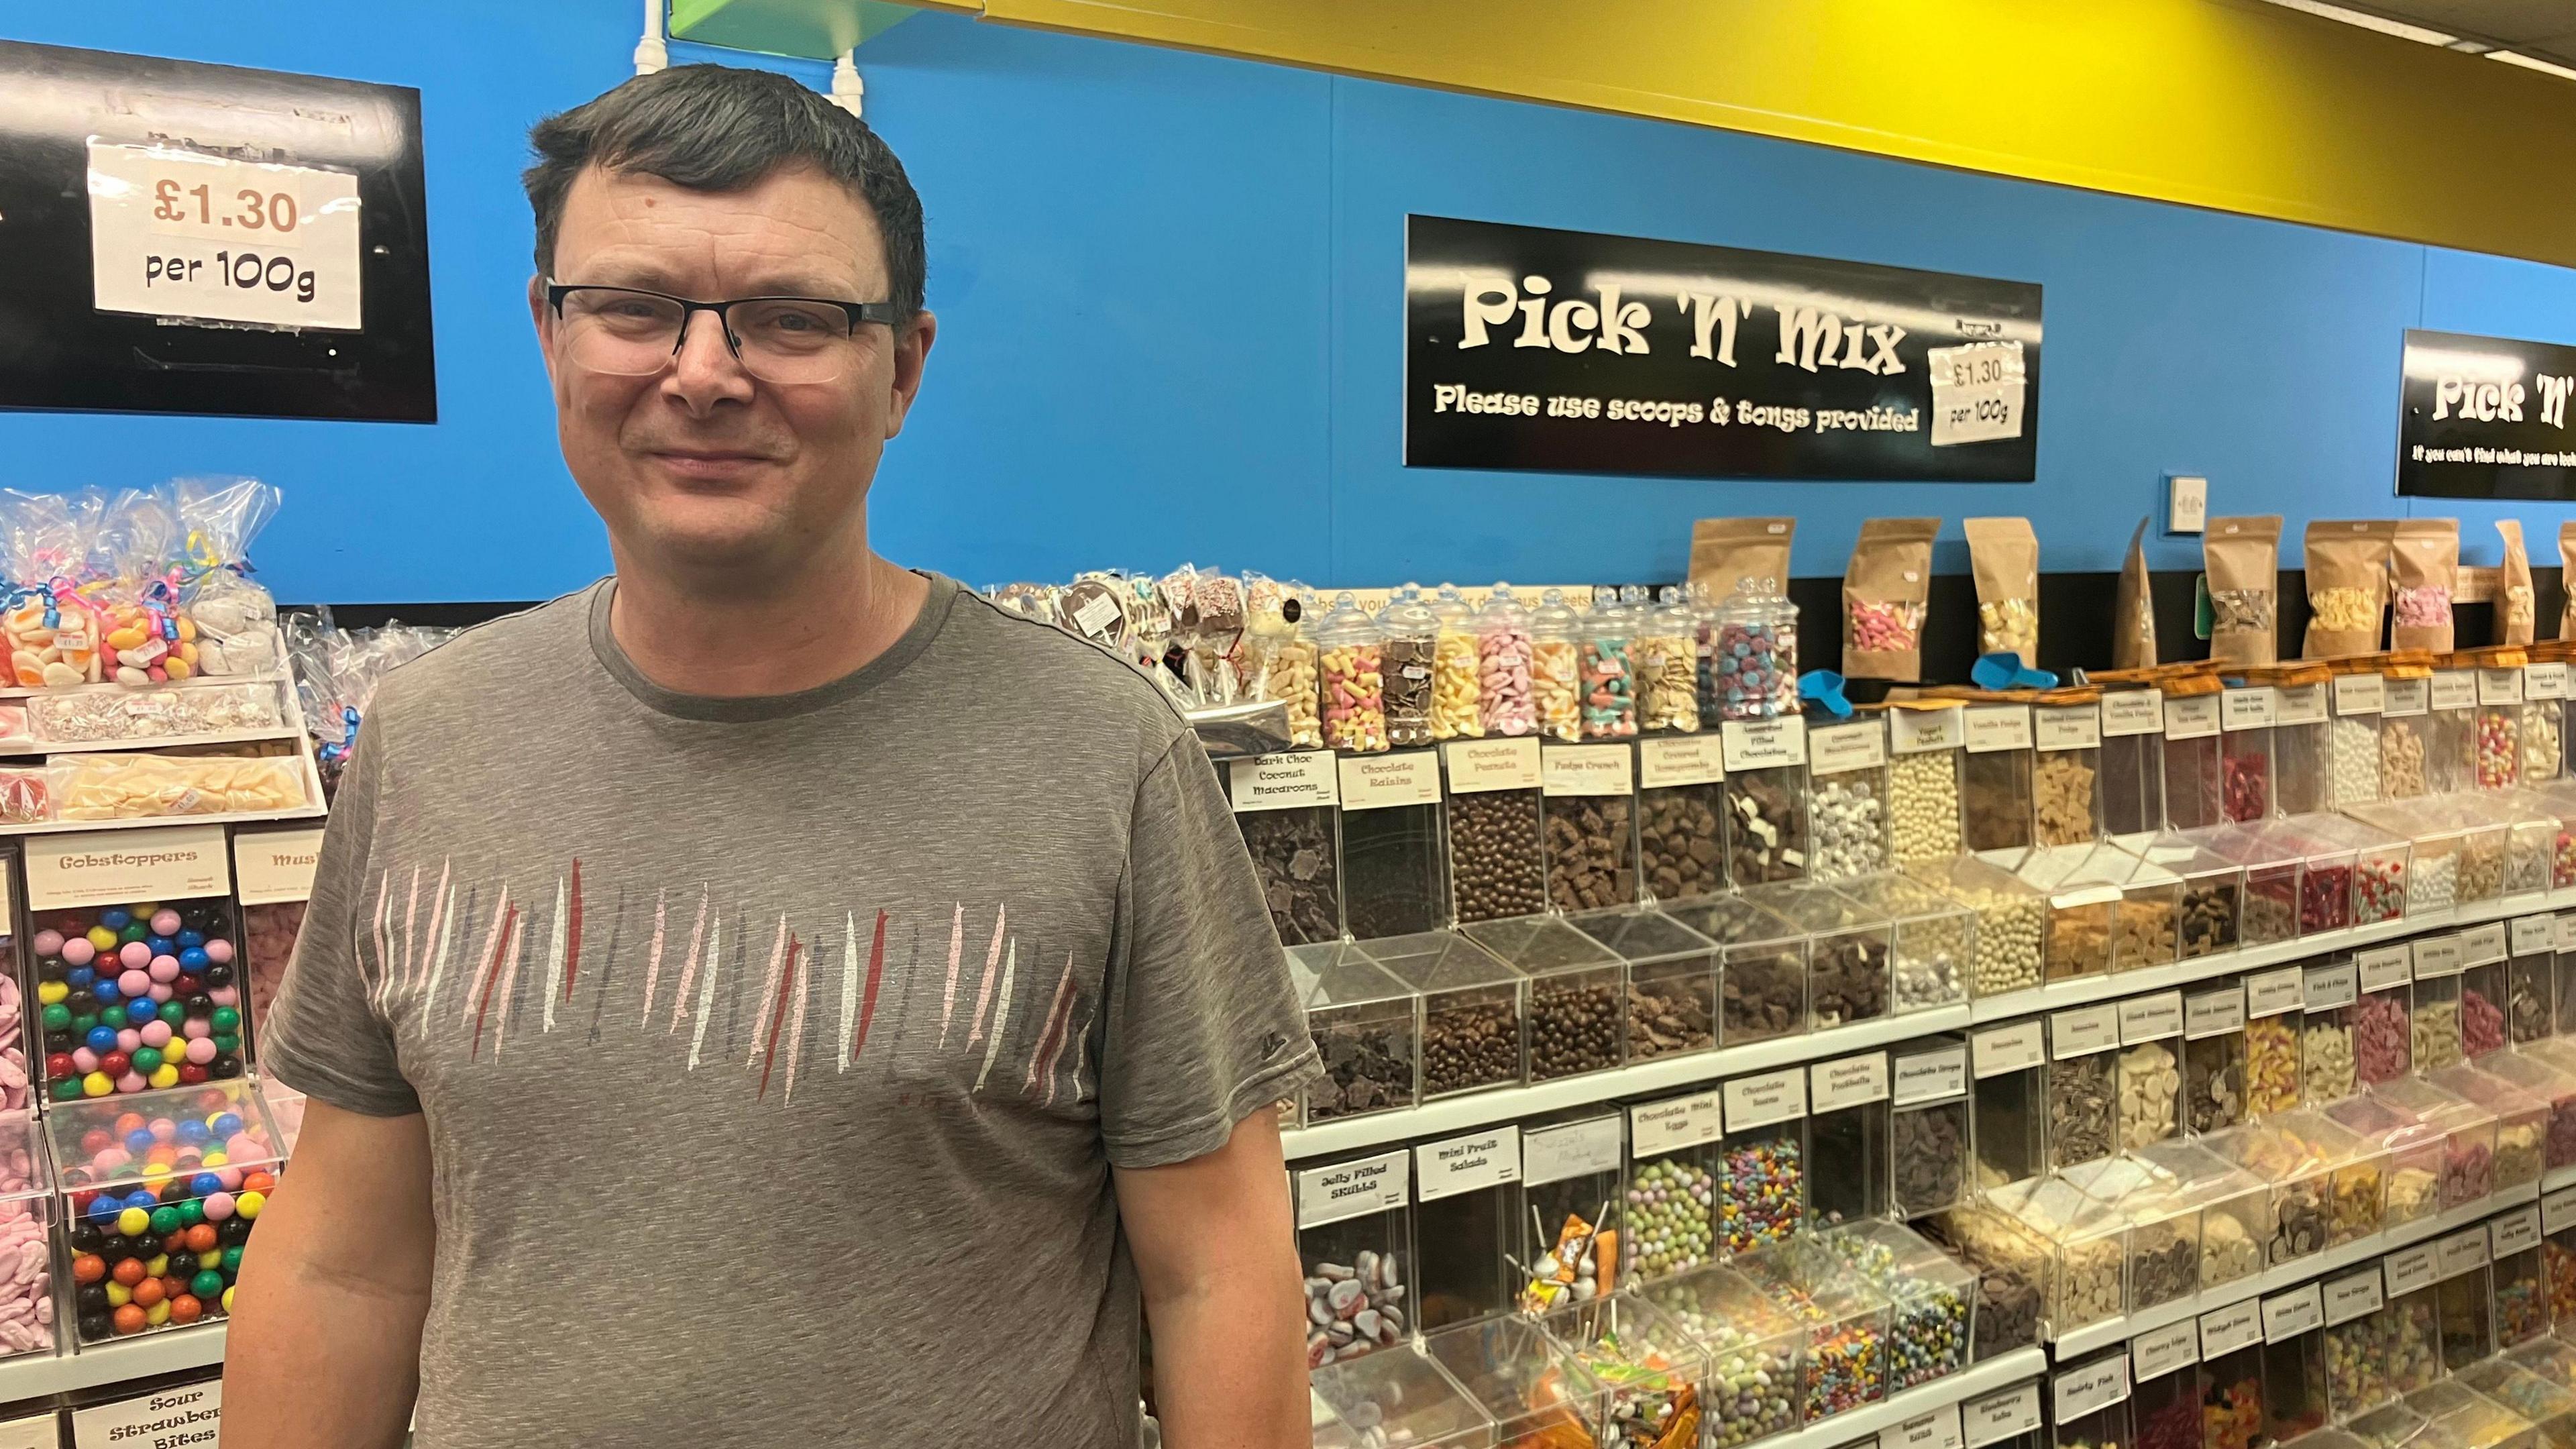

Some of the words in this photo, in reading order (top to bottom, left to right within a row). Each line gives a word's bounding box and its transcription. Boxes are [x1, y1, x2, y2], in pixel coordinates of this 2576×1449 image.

[154, 179, 297, 232] £1.30
[146, 254, 202, 287] per
[217, 251, 315, 303] 100g
[1458, 271, 1652, 356] Pick
[1773, 302, 1907, 376] Mix
[1953, 360, 2001, 388] £1.30
[1434, 382, 1540, 417] Please
[1547, 395, 1601, 419] use
[1607, 399, 1704, 427] scoops
[1709, 396, 1731, 427] &
[1736, 399, 1811, 433] tongs
[1815, 405, 1919, 433] provided
[2432, 374, 2526, 423] Pick
[1949, 407, 1970, 429] per
[1975, 399, 2008, 425] 100g
[2412, 444, 2424, 462] If
[2424, 448, 2445, 464] you
[2446, 447, 2473, 464] can't
[2473, 447, 2496, 464] find
[2496, 448, 2522, 465] what
[2522, 452, 2540, 467] you
[2540, 452, 2559, 466] are
[1253, 755, 1283, 765] Dark
[1286, 754, 1312, 764] Choc
[1468, 747, 1517, 759] Chocolate
[1259, 768, 1305, 780] Coconut
[1361, 763, 1415, 774] Chocolate
[1474, 761, 1517, 772] Peanuts
[1585, 760, 1620, 771] Crunch
[1252, 784, 1318, 795] Macaroons
[1370, 776, 1412, 787] Raisins
[59, 849, 199, 871] Gobstoppers
[272, 851, 320, 866] Mus
[1638, 1106, 1687, 1124] Chocolate
[1438, 1145, 1466, 1160] Mini
[1467, 1139, 1499, 1157] Fruit
[1450, 1155, 1488, 1173] Salads
[1322, 1173, 1351, 1187] Jelly
[1354, 1163, 1388, 1180] Filled
[150, 1391, 203, 1411] Sour
[152, 1430, 216, 1449] Bites
